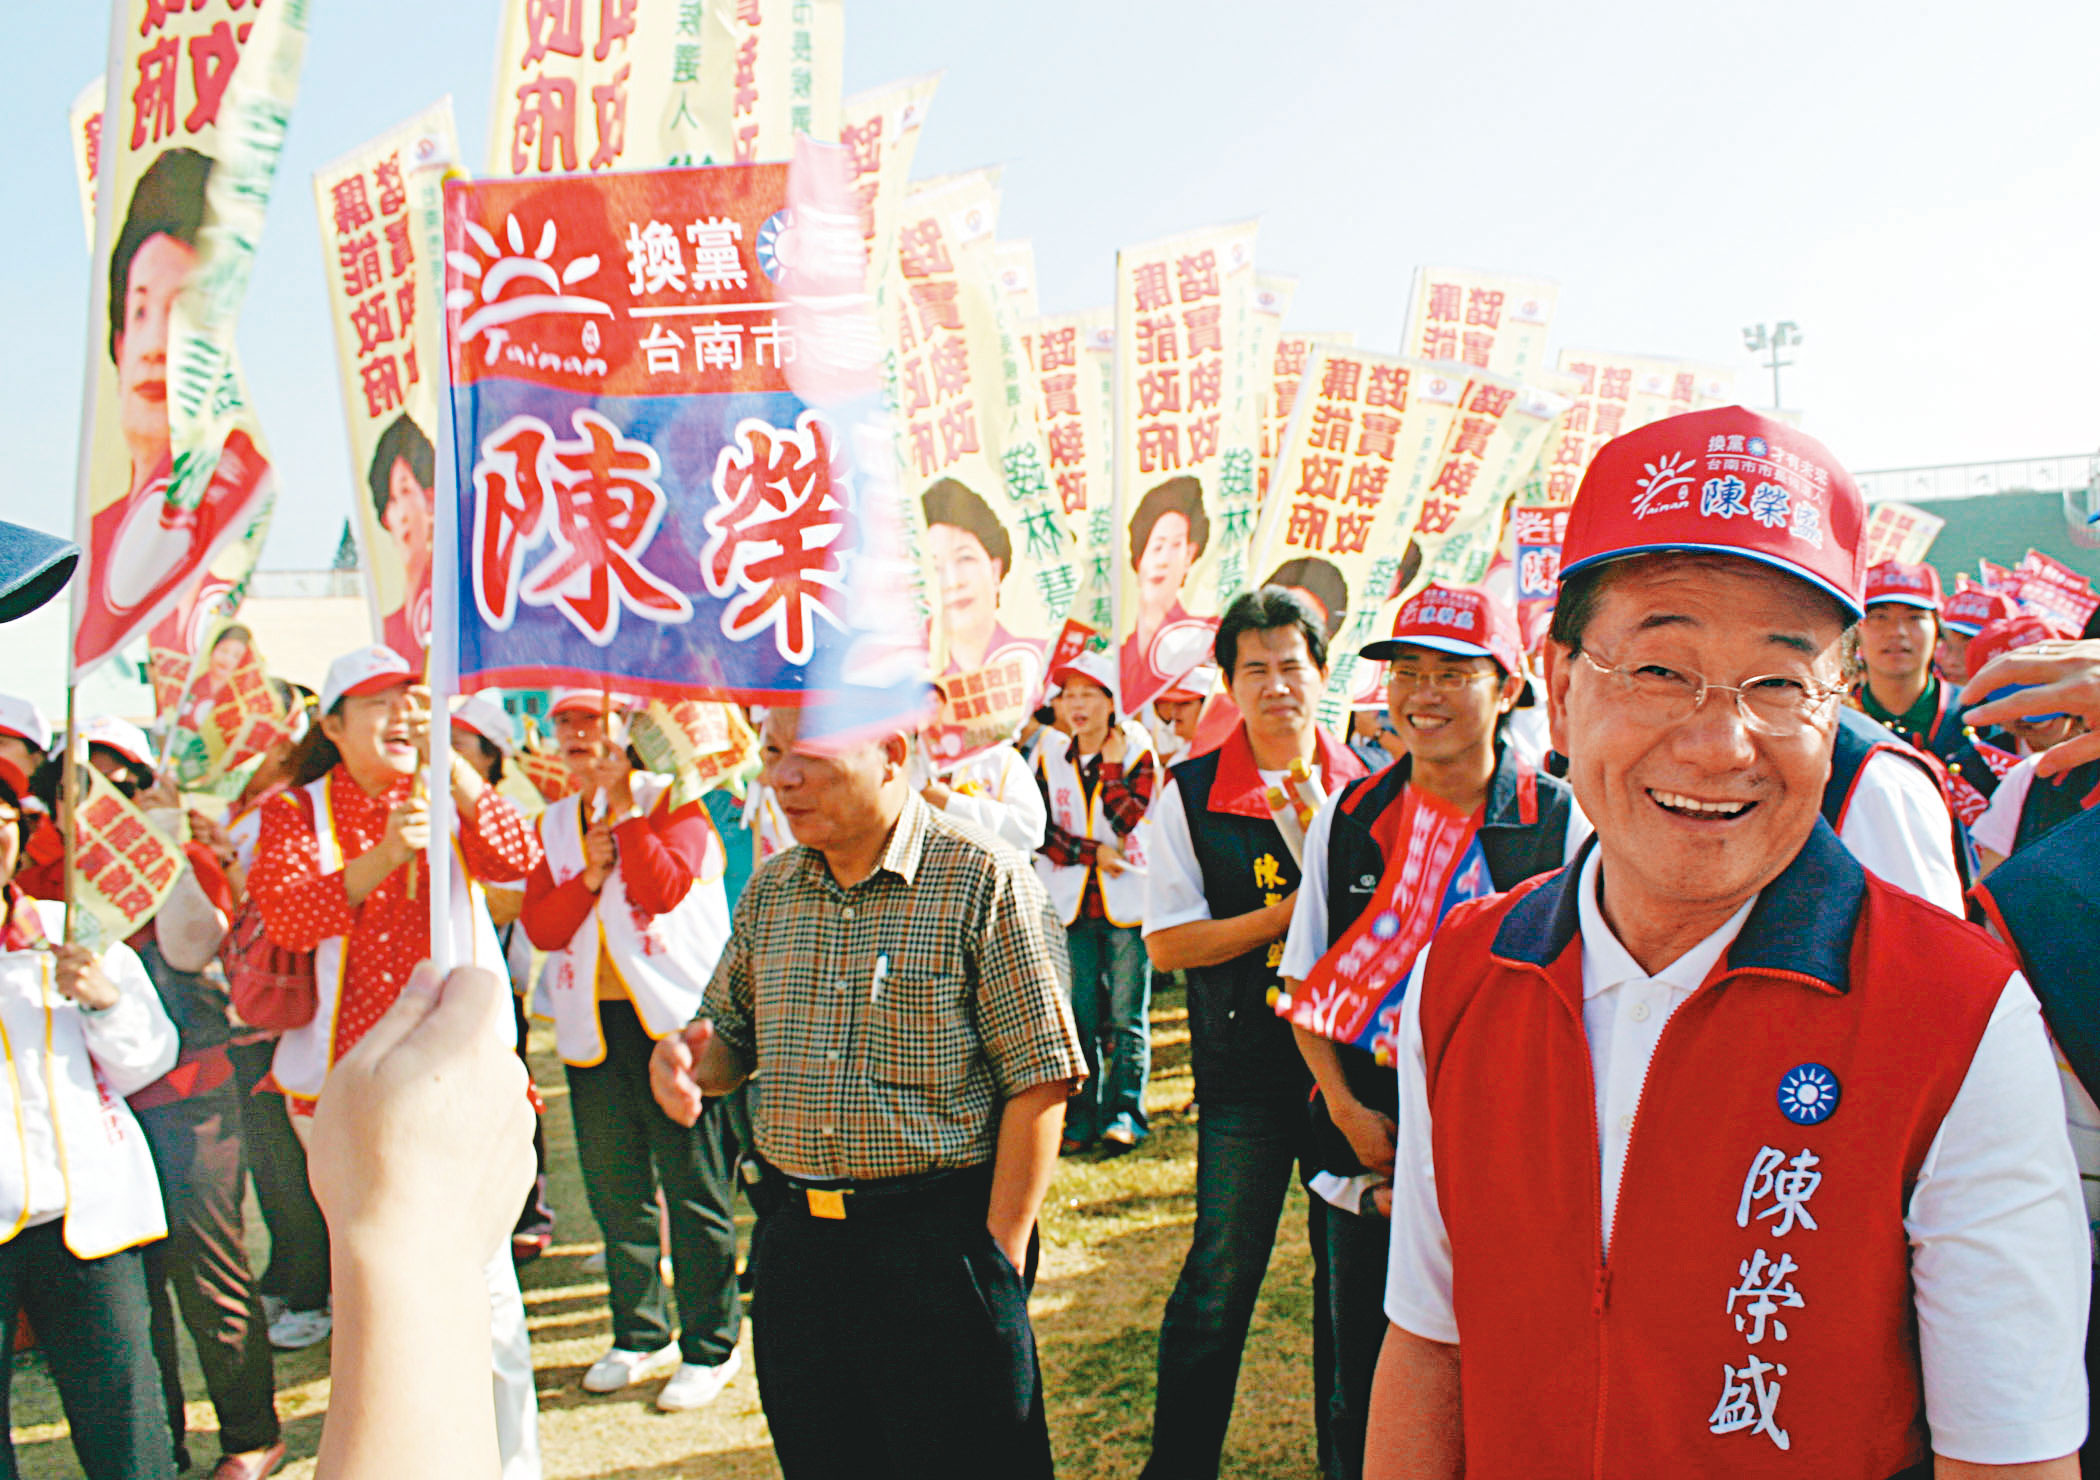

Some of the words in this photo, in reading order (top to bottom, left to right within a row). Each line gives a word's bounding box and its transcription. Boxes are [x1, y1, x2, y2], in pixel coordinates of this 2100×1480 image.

[624, 215, 749, 297] 換黨
[484, 327, 608, 377] Tainan
[639, 318, 796, 375] 台南市
[1707, 434, 1745, 453] 換黨
[1770, 446, 1829, 487] 才有未來
[472, 408, 852, 668] 陳榮
[1636, 498, 1691, 520] Tainan
[1701, 474, 1824, 551] 陳榮盛
[1708, 1144, 1823, 1452] 陳榮盛
